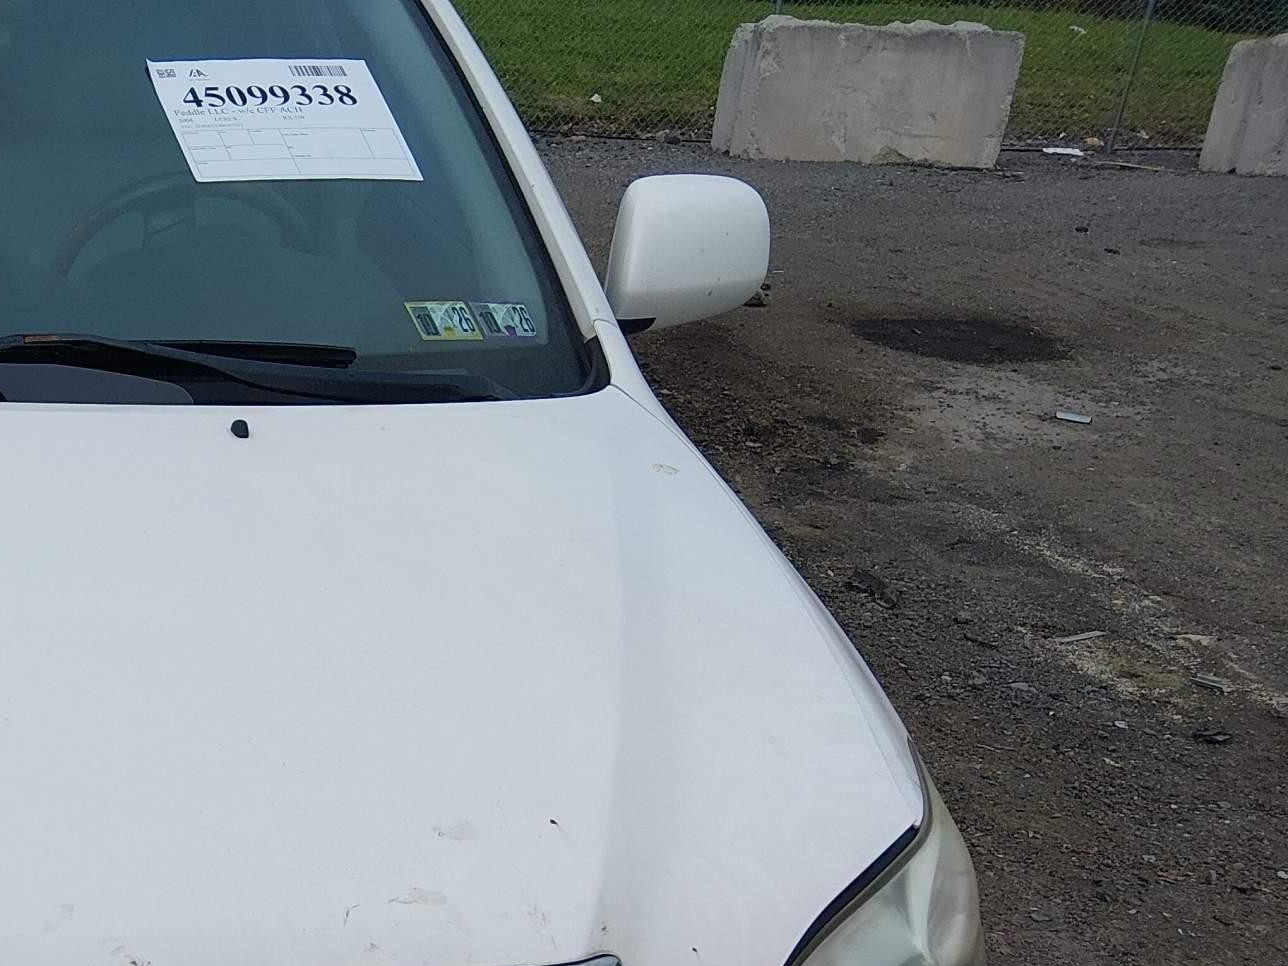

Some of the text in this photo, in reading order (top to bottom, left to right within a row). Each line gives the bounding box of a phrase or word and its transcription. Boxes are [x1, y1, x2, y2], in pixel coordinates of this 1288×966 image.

[183, 85, 358, 108] 45099338
[174, 107, 205, 117] Peddle
[208, 106, 229, 115] LLC
[417, 306, 476, 336] 10 26
[478, 306, 536, 334] 10 26
